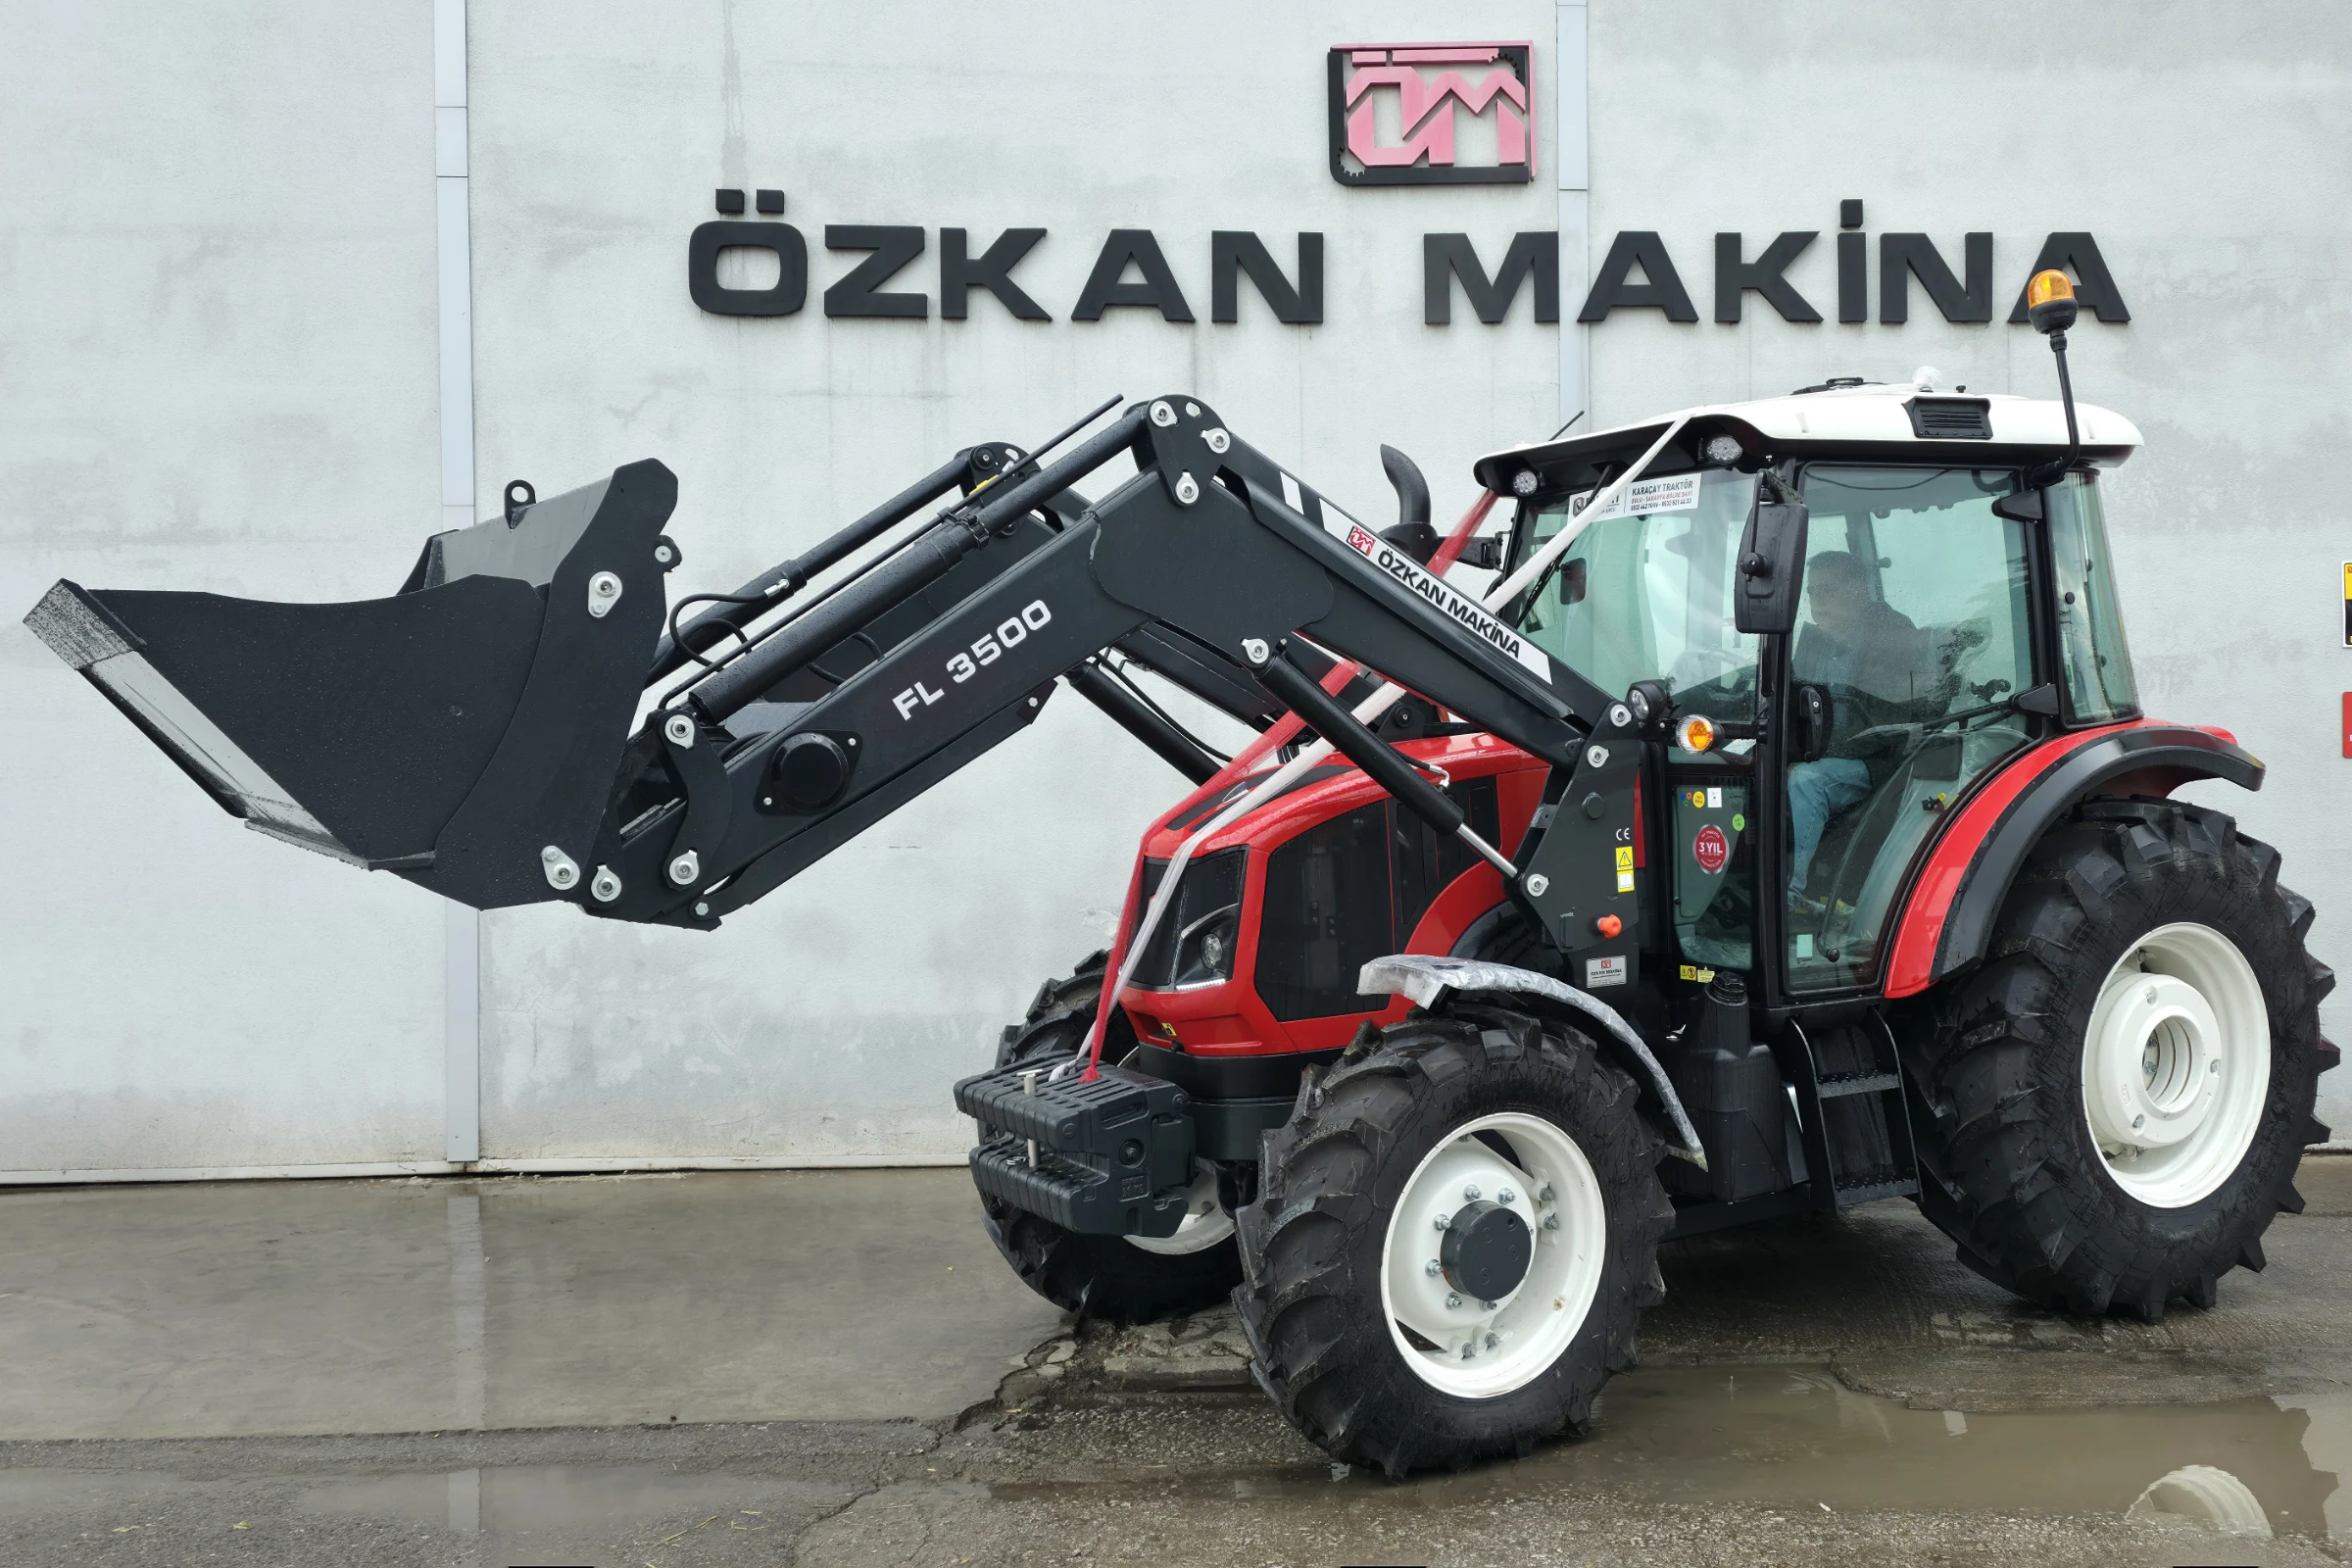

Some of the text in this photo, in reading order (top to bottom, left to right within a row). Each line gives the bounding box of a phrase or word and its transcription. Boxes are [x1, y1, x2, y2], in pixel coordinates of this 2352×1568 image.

[688, 188, 2132, 324] ÖZKAN MAKİNA
[1632, 478, 1693, 497] KARAÇAY TRAKTÖR
[1377, 548, 1520, 659] ÖZKAN MAKİNA
[892, 600, 1052, 721] FL 3500
[1698, 842, 1723, 854] 3 YIL
